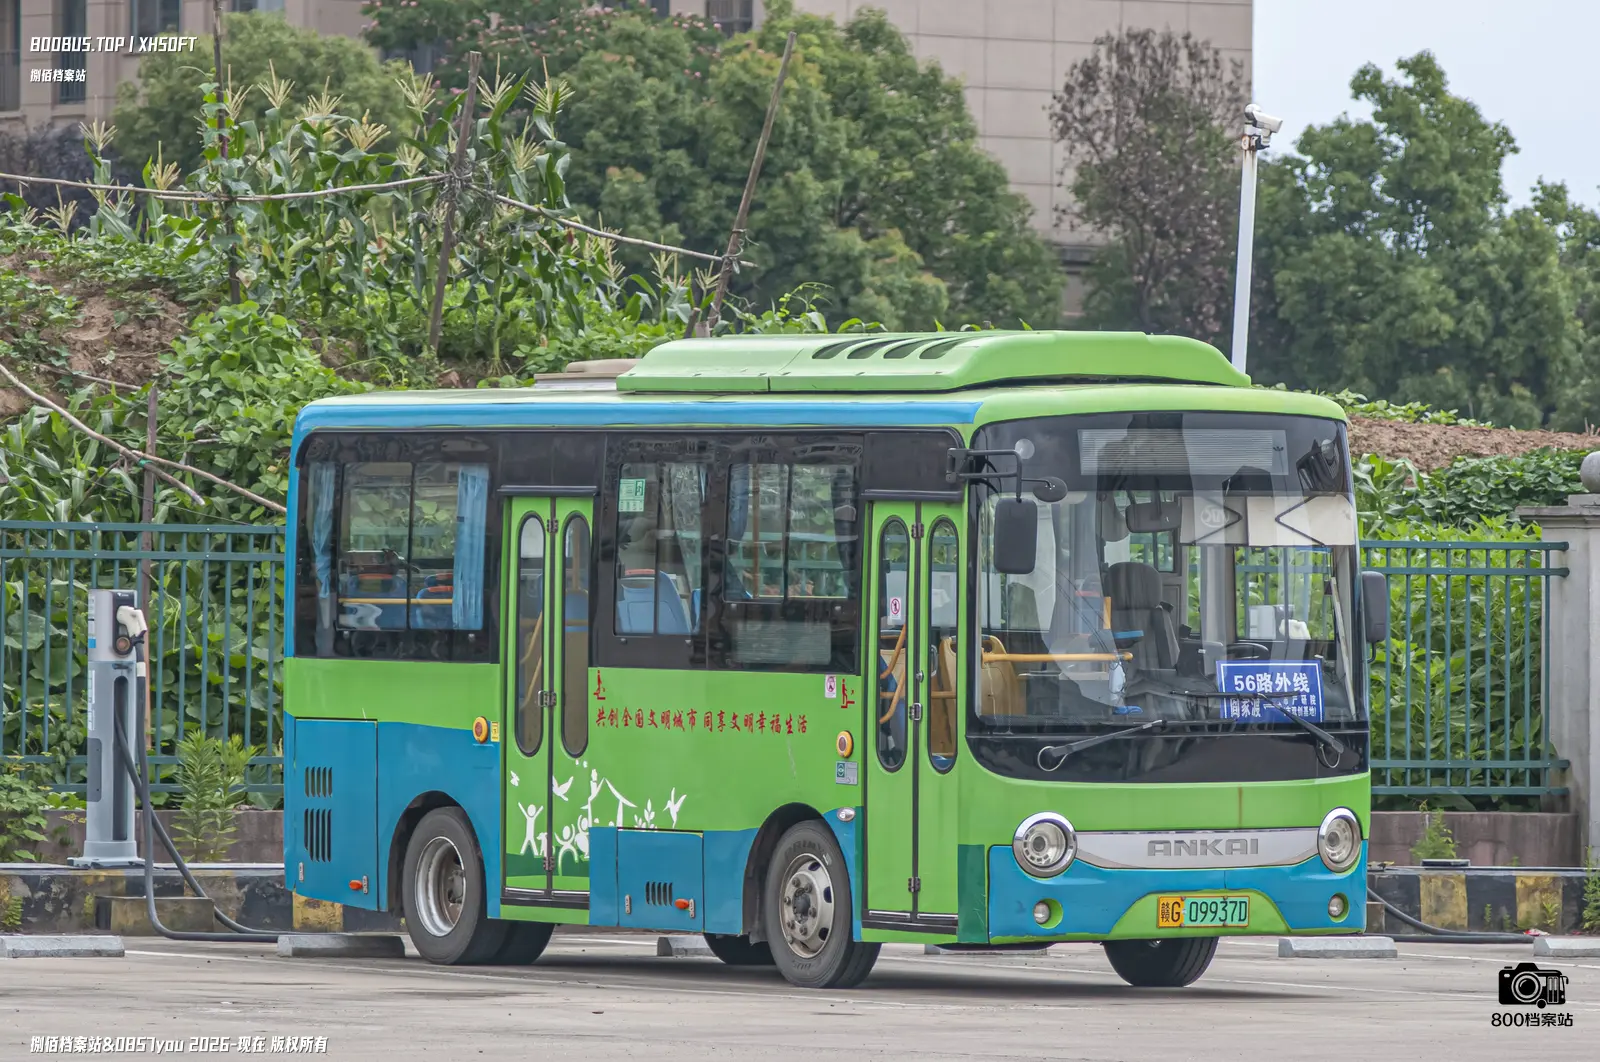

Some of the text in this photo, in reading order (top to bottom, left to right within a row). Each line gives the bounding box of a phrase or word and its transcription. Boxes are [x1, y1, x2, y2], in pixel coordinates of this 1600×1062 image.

[1233, 672, 1310, 693] 56路外线
[595, 706, 808, 735] 共创全国文明城市 同享文明幸福生活
[1147, 838, 1259, 857] ANKAI
[1160, 900, 1248, 923] 赣G 09937D
